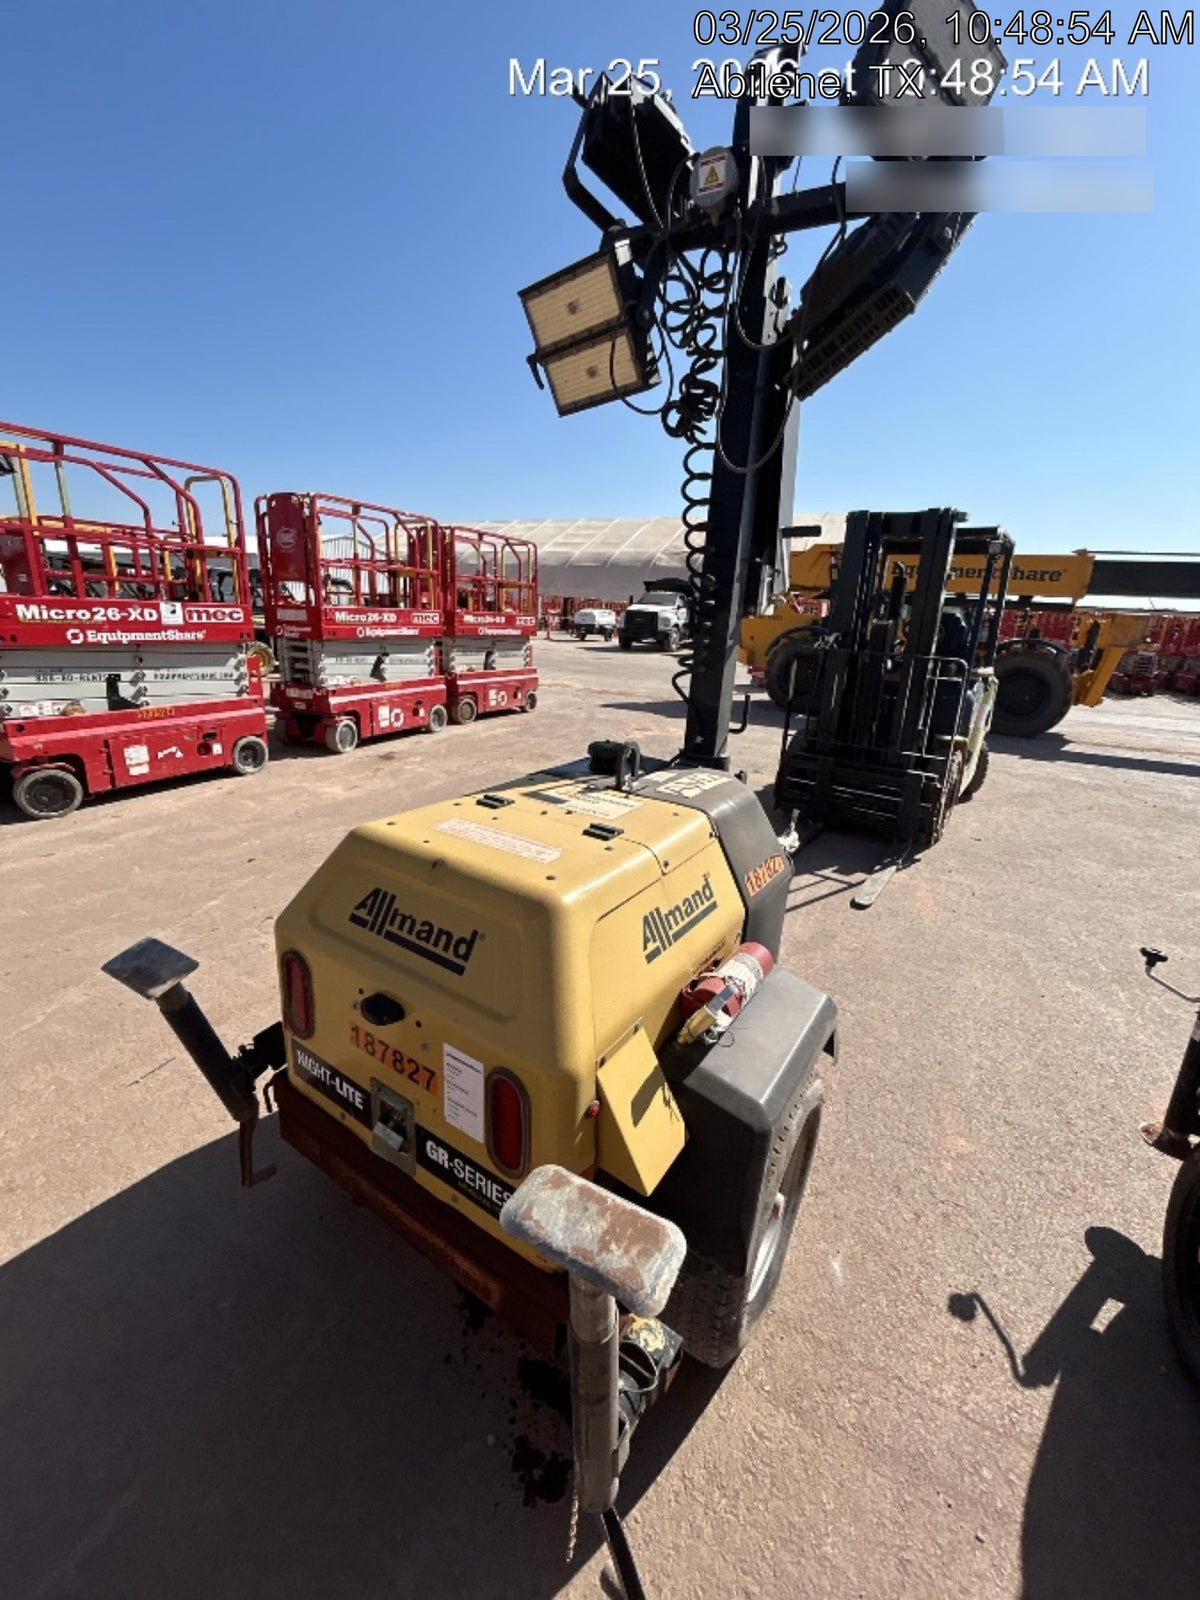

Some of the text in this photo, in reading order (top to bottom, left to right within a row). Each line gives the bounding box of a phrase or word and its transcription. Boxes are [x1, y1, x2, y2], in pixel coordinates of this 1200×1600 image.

[86, 629, 207, 644] EquipmentShare
[186, 608, 243, 622] mec
[353, 887, 479, 966] Allmand
[643, 876, 715, 954] Allmand
[296, 1049, 365, 1111] NIGHT-LITE
[351, 1024, 436, 1092] 187827
